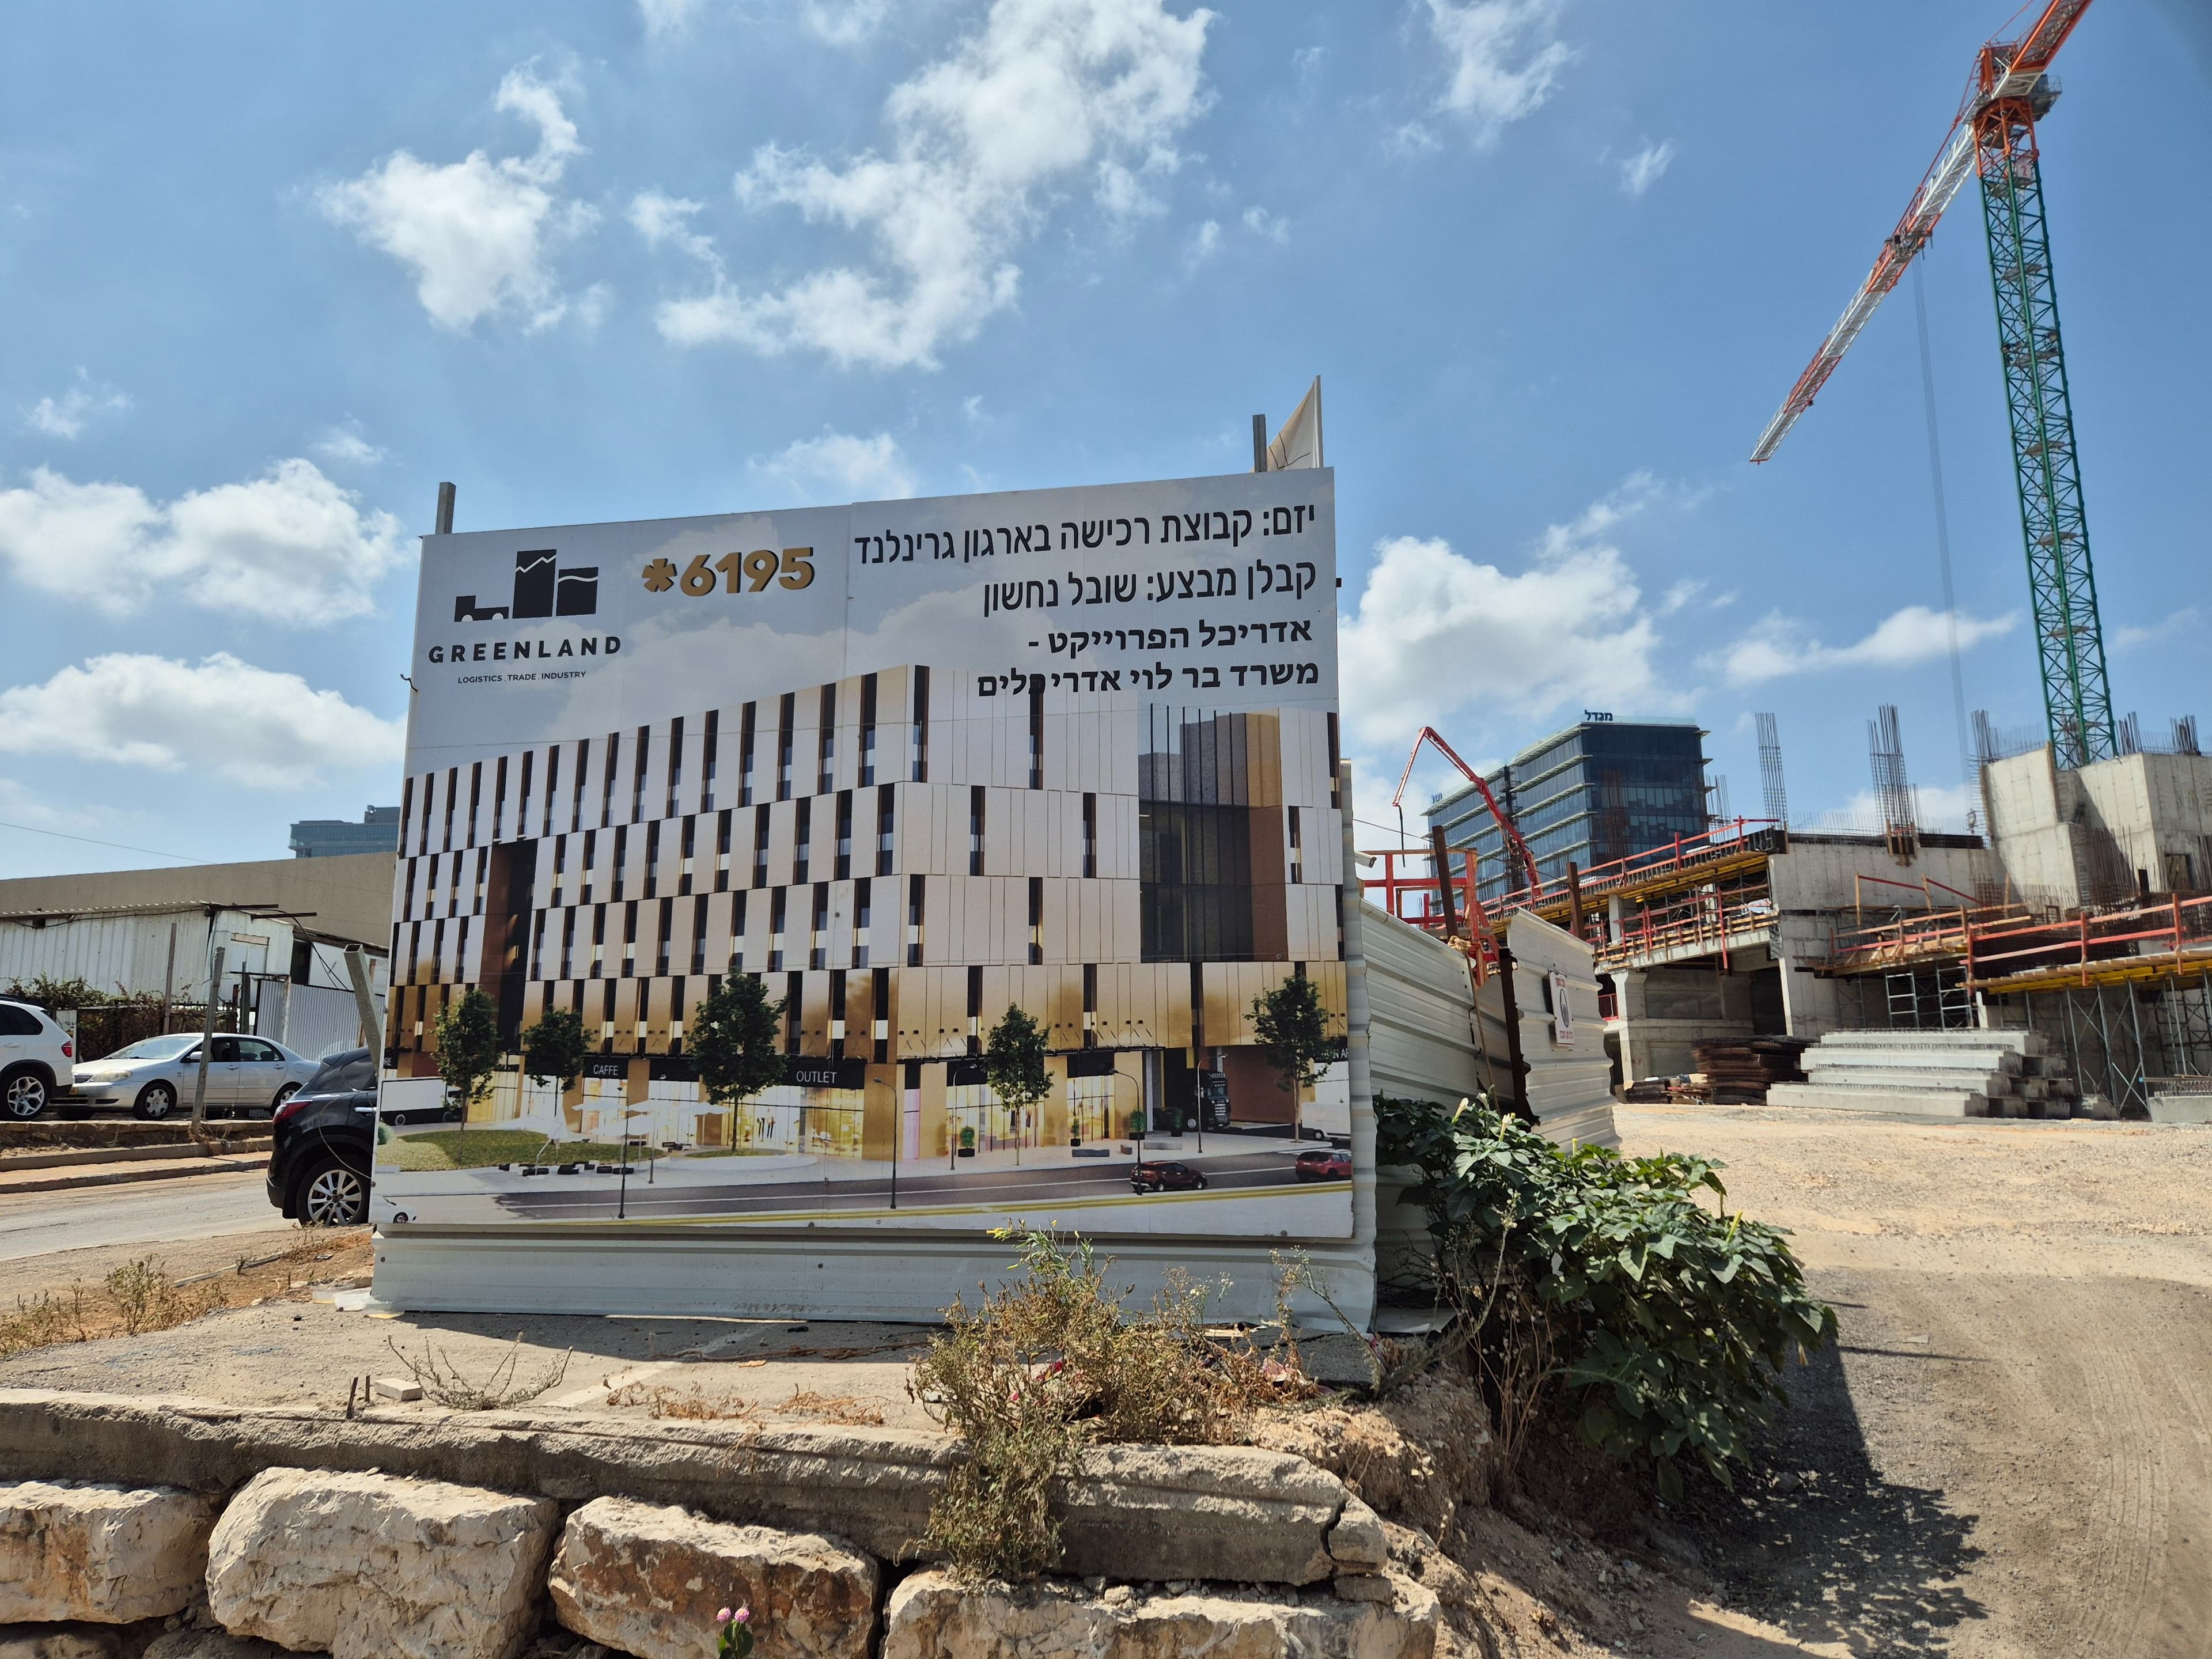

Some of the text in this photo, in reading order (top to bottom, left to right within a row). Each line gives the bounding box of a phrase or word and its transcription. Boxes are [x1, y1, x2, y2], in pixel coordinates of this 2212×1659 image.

[2021, 165, 2028, 176] 2
[854, 504, 1315, 565] יזם: קבוצת רכישה בארגון גרינלנד
[984, 559, 1316, 618] קבלן מבצע: שובל נחשון
[1048, 624, 1189, 659] הפרוייקט
[1199, 619, 1313, 648] אדריכל
[429, 636, 621, 664] GREENLAND
[457, 675, 503, 684] LOGISTICS
[978, 661, 1319, 697] משרד בר לוי אדריכלים
[1584, 709, 1613, 721] מגדל
[593, 1064, 618, 1075] CAFFE
[796, 1070, 838, 1084] OUTLET
